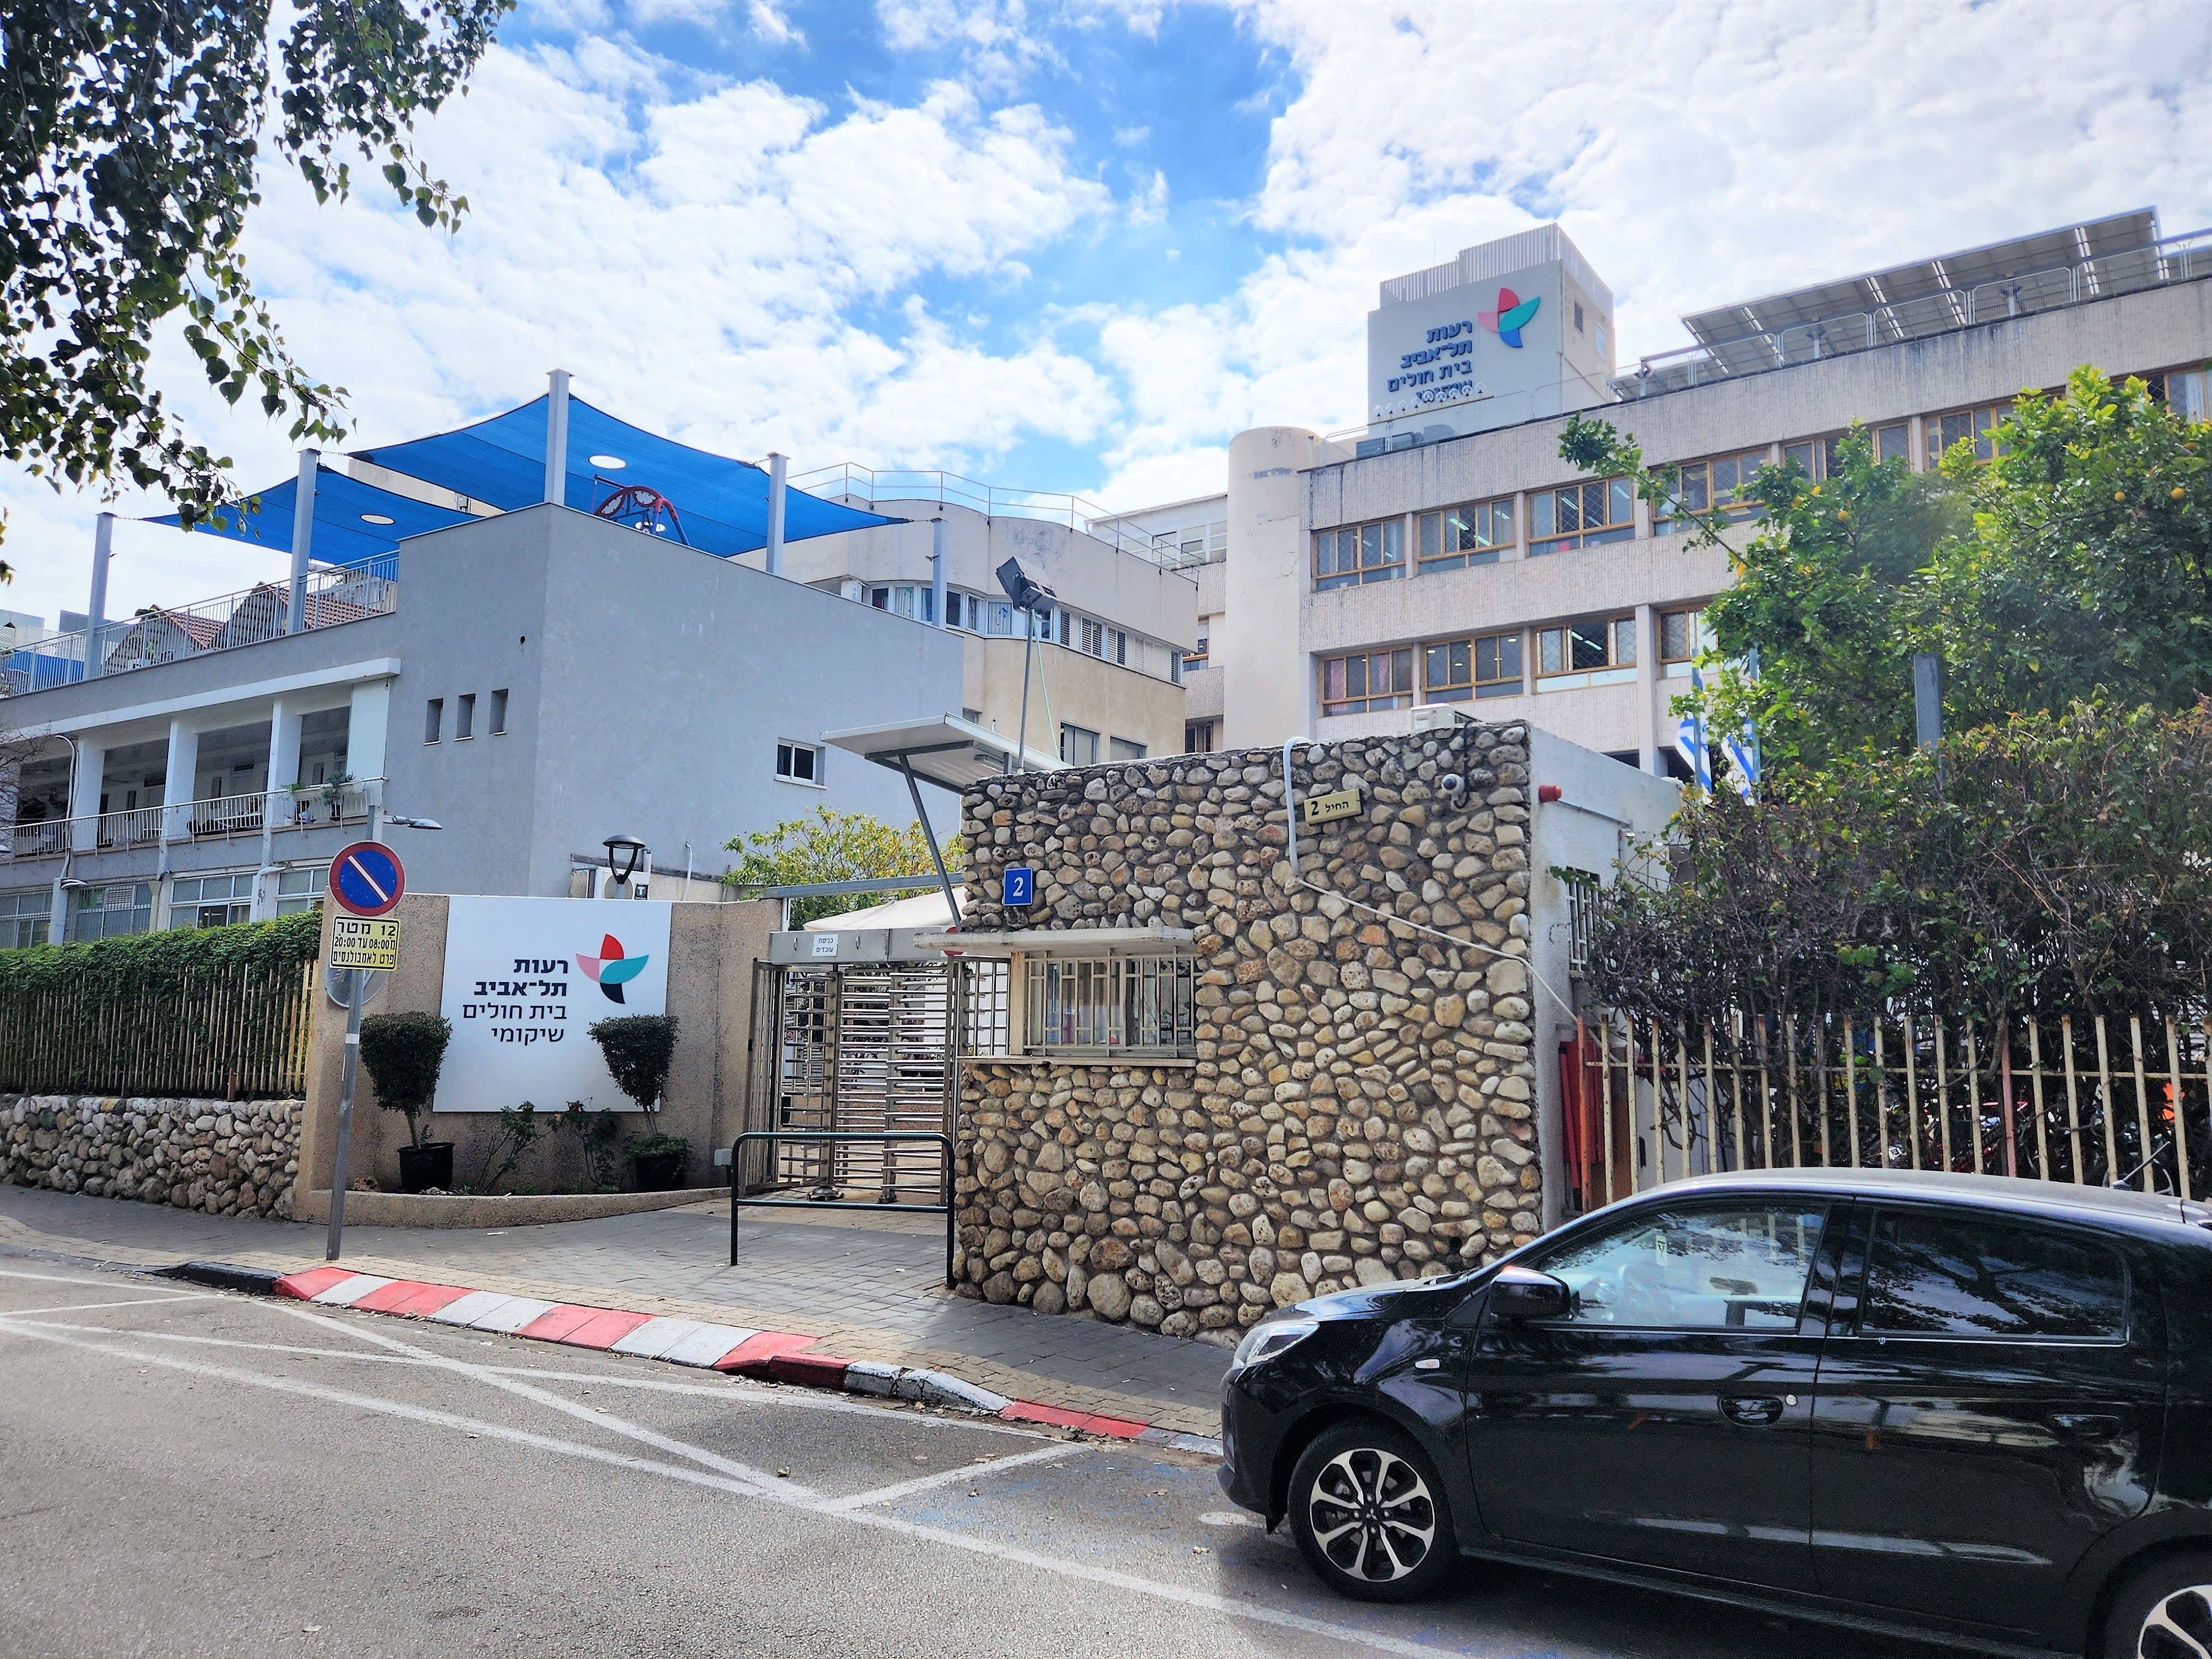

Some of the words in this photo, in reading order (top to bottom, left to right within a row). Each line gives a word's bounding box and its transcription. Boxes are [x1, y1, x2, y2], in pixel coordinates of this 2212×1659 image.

[1427, 320, 1473, 343] רעות
[1439, 359, 1473, 380] בית
[1387, 369, 1434, 392] חולים
[1311, 800, 1319, 816] 2
[1325, 801, 1349, 813] החיל
[1013, 877, 1024, 897] 2
[337, 921, 371, 935] מטר
[381, 925, 396, 936] 12
[334, 936, 356, 948] 20:00
[357, 937, 368, 948] עד
[333, 950, 376, 964] לאמבולנסים
[379, 954, 394, 964] פרט
[514, 959, 568, 974] רעות
[463, 1002, 523, 1019] חולים
[529, 1005, 567, 1019] בית
[492, 1028, 564, 1046] שיקומי
